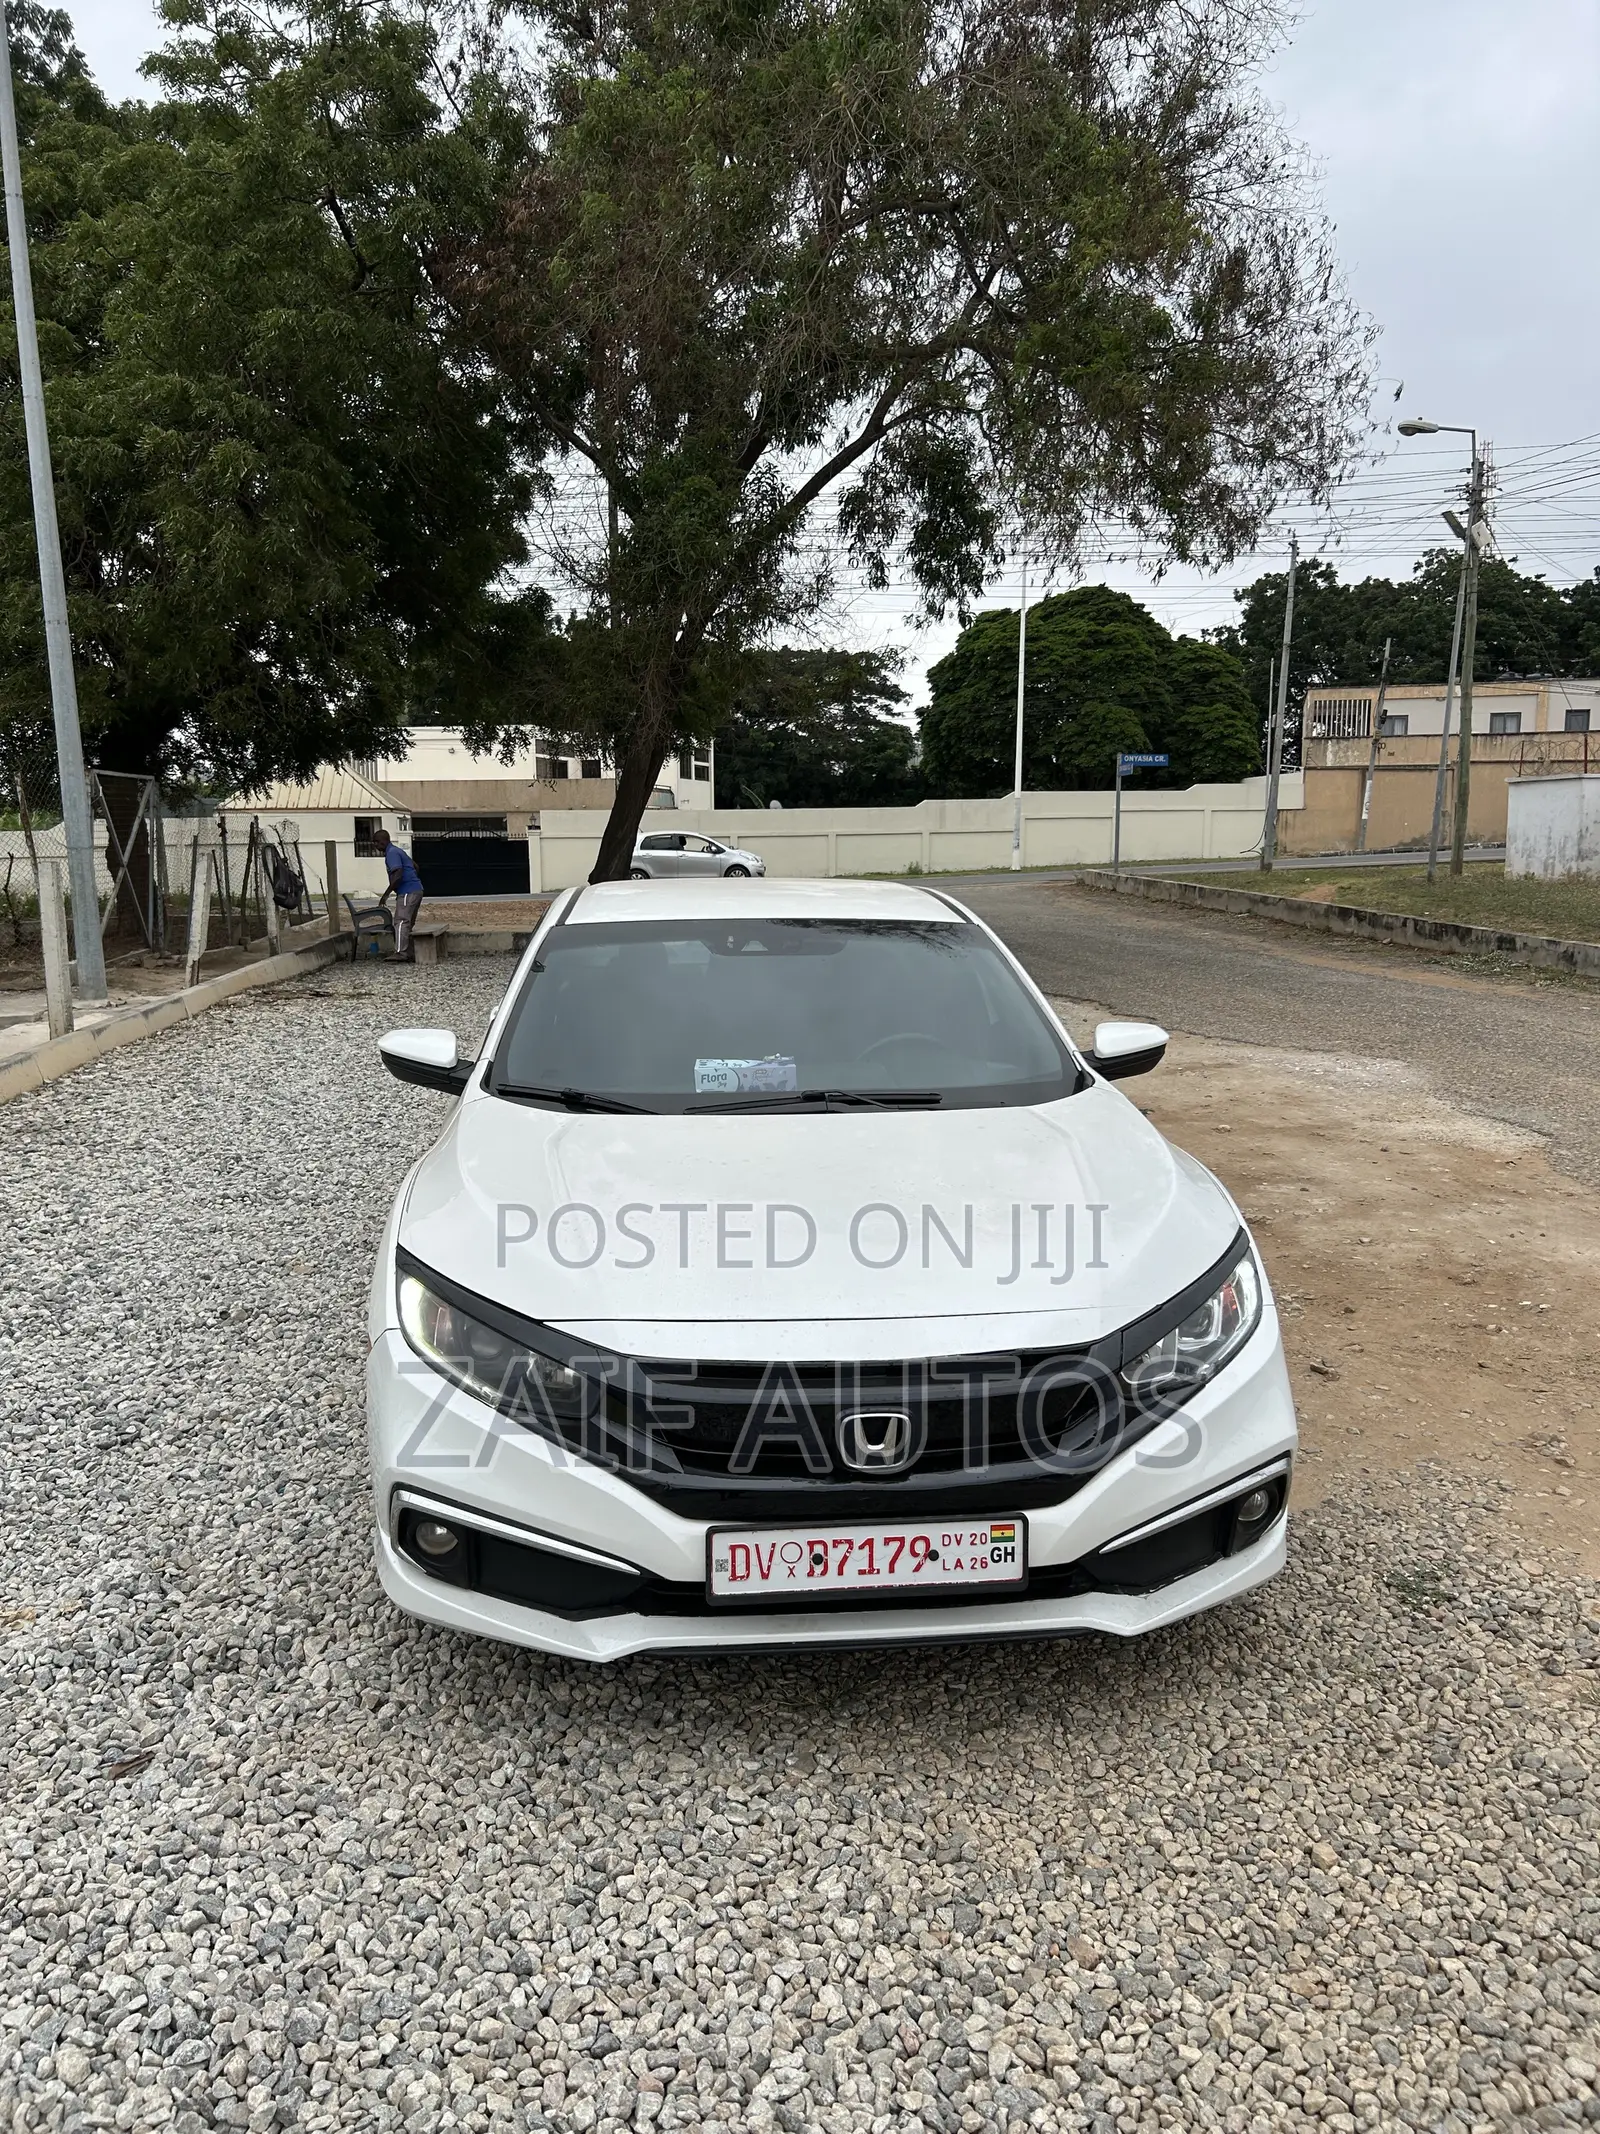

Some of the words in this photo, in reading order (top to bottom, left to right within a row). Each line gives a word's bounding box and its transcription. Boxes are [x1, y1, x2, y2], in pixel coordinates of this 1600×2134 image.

[701, 1072, 727, 1084] Flora
[941, 1534, 963, 1547] DV
[969, 1532, 988, 1546] 20
[728, 1543, 776, 1582] DV
[990, 1546, 1015, 1564] GH
[942, 1557, 964, 1571] LA
[970, 1557, 988, 1570] 26
